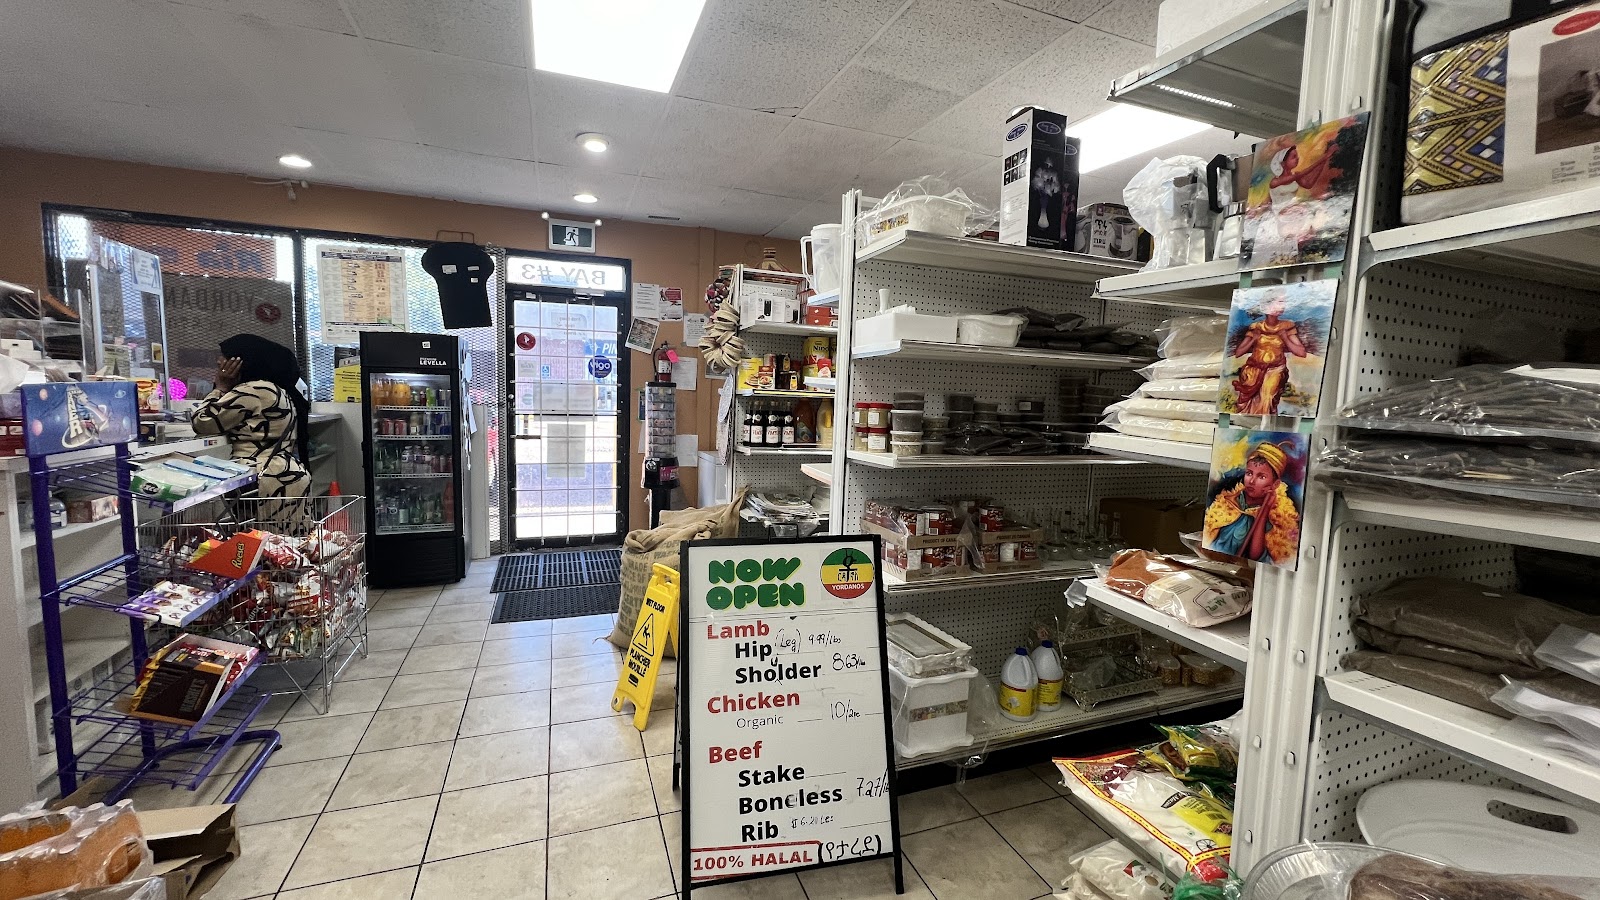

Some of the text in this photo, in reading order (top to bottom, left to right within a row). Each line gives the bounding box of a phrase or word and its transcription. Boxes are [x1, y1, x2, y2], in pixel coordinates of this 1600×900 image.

[708, 557, 801, 584] NOW
[706, 582, 805, 611] OPEN
[707, 620, 770, 640] Lamb
[735, 640, 772, 662] Hip
[735, 663, 822, 684] Sholder
[707, 691, 801, 714] Chicken
[736, 714, 784, 730] Organic
[708, 741, 763, 764] Beef
[738, 765, 805, 788] Stake
[738, 787, 843, 815] Boneless
[741, 820, 779, 843] Rib
[693, 850, 813, 871] 100% HALAL
